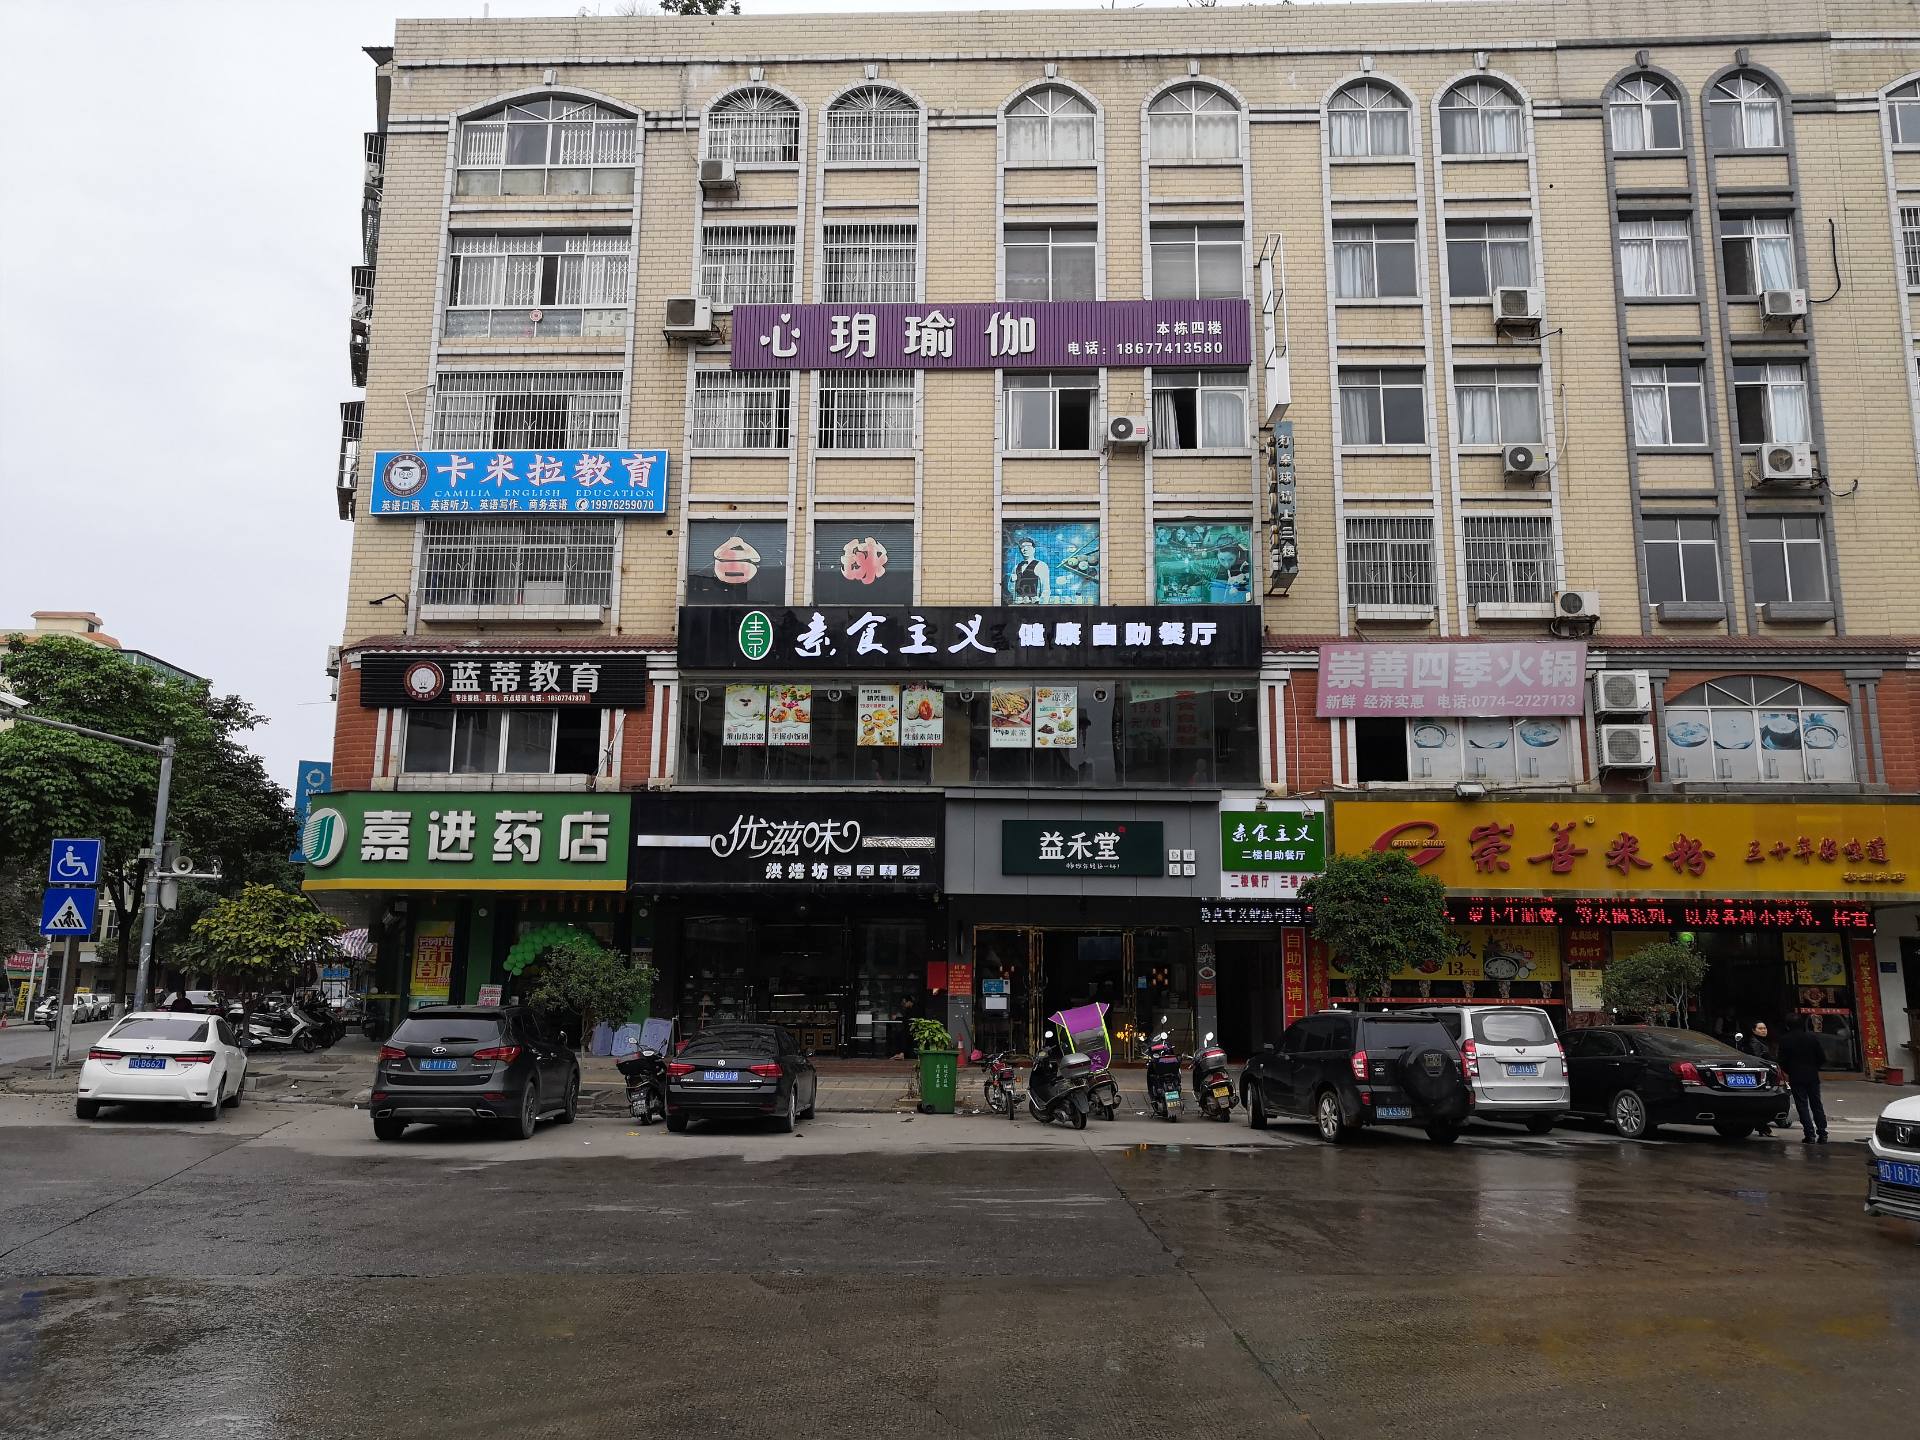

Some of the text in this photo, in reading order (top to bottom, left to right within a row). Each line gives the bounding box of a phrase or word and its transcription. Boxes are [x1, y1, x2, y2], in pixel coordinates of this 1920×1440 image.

[760, 311, 1036, 359] 心玥瑜伽
[1157, 321, 1222, 336] 本栋四楼
[437, 453, 657, 488] 卡米拉教育
[434, 488, 655, 498] CAMILIA ENGLISH EDUCATION
[590, 499, 654, 510] 19976259070
[795, 611, 1218, 656] 素食主义 健康自助餐厅
[449, 661, 602, 693] 蓝蒂教育
[1327, 650, 1577, 689] 崇善四季火锅
[1326, 695, 1356, 709] 新鲜
[1364, 694, 1425, 709] 经济实惠
[360, 810, 610, 863] 嘉进药店
[711, 814, 861, 859] 优滋味
[1038, 831, 1121, 860] 益禾堂
[1232, 822, 1315, 842] 素食主义
[1241, 849, 1306, 861] 二楼自助餐厅
[1469, 821, 1716, 876] 崇善米粉
[1230, 874, 1270, 888] 二楼餐厅
